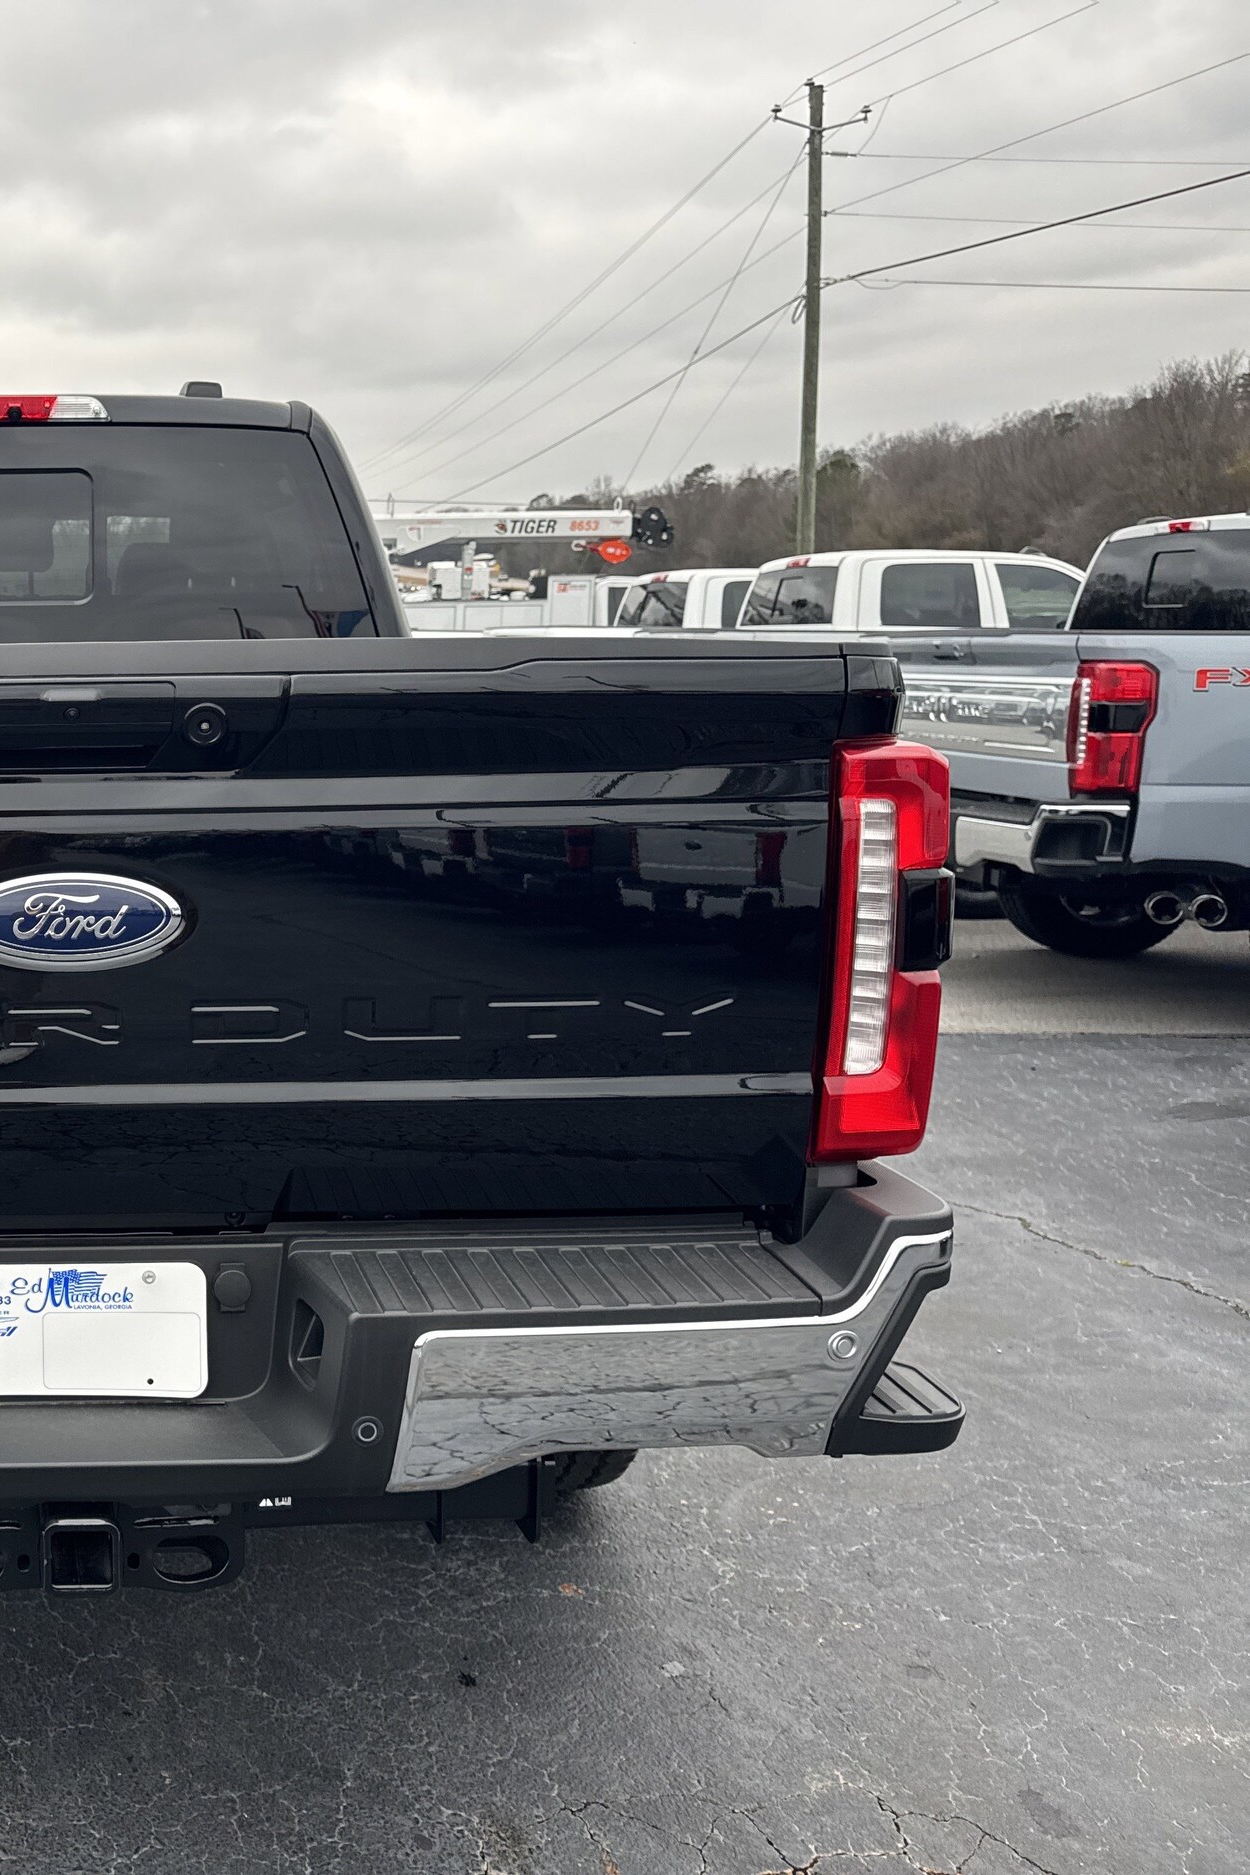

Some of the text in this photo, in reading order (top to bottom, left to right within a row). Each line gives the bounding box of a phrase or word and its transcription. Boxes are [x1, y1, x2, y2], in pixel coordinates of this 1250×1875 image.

[509, 520, 599, 534] TIGER 8653
[12, 892, 131, 941] Ford
[190, 995, 734, 1045] DUTY
[10, 1274, 134, 1314] Ed Murdock
